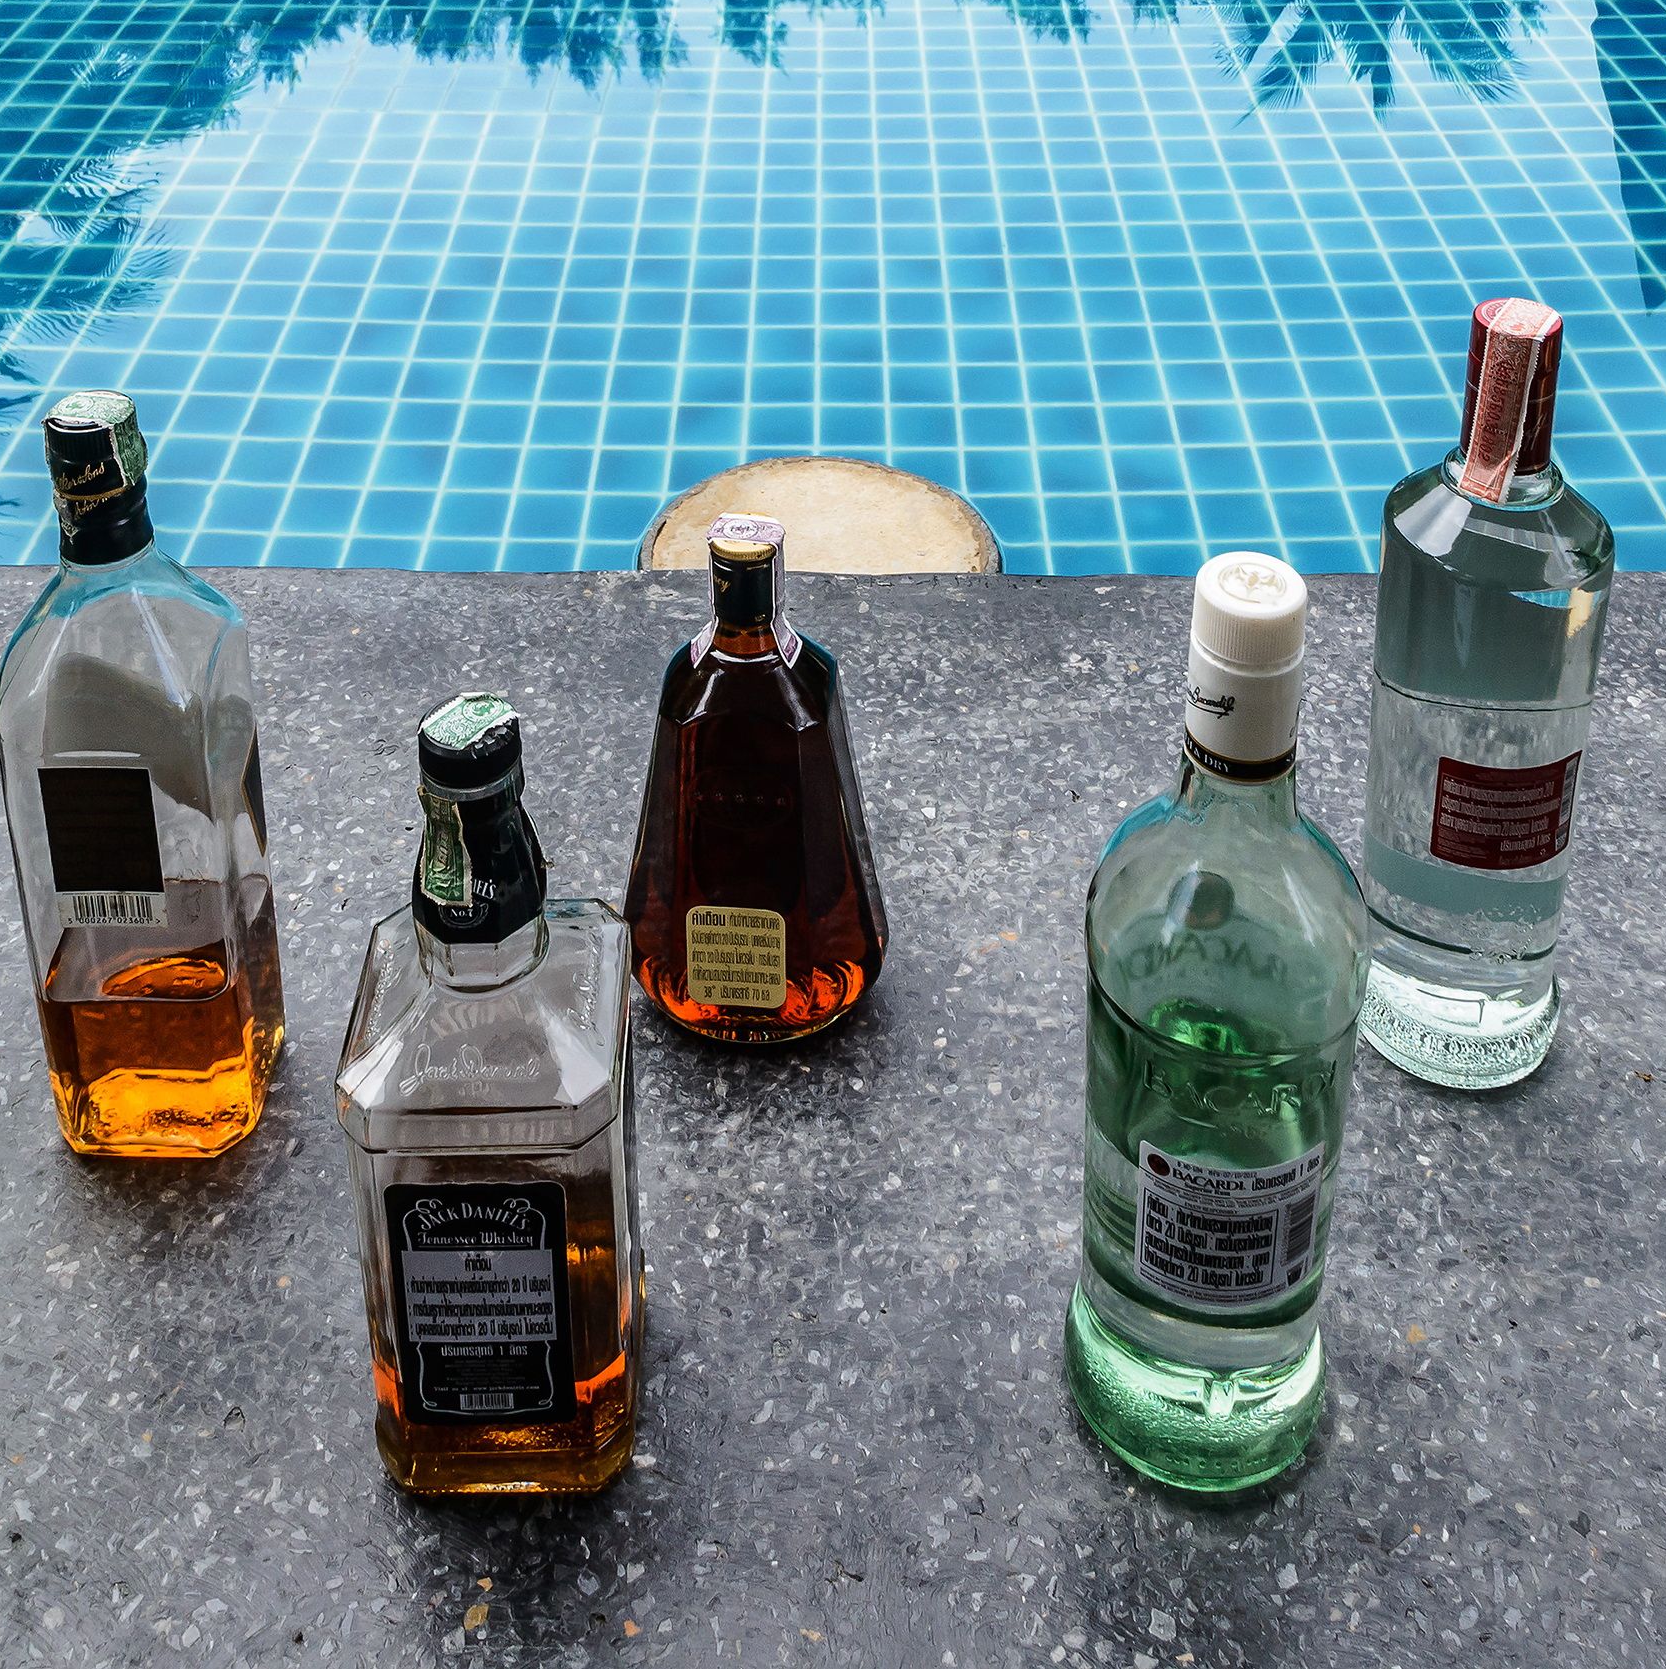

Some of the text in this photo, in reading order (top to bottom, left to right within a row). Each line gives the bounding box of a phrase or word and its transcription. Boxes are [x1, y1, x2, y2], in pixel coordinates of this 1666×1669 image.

[1203, 753, 1230, 773] DRY
[1172, 1168, 1244, 1191] BACARDI
[419, 1202, 531, 1231] JACK DANIEL'S
[417, 1231, 534, 1247] Tennessee Whiskey
